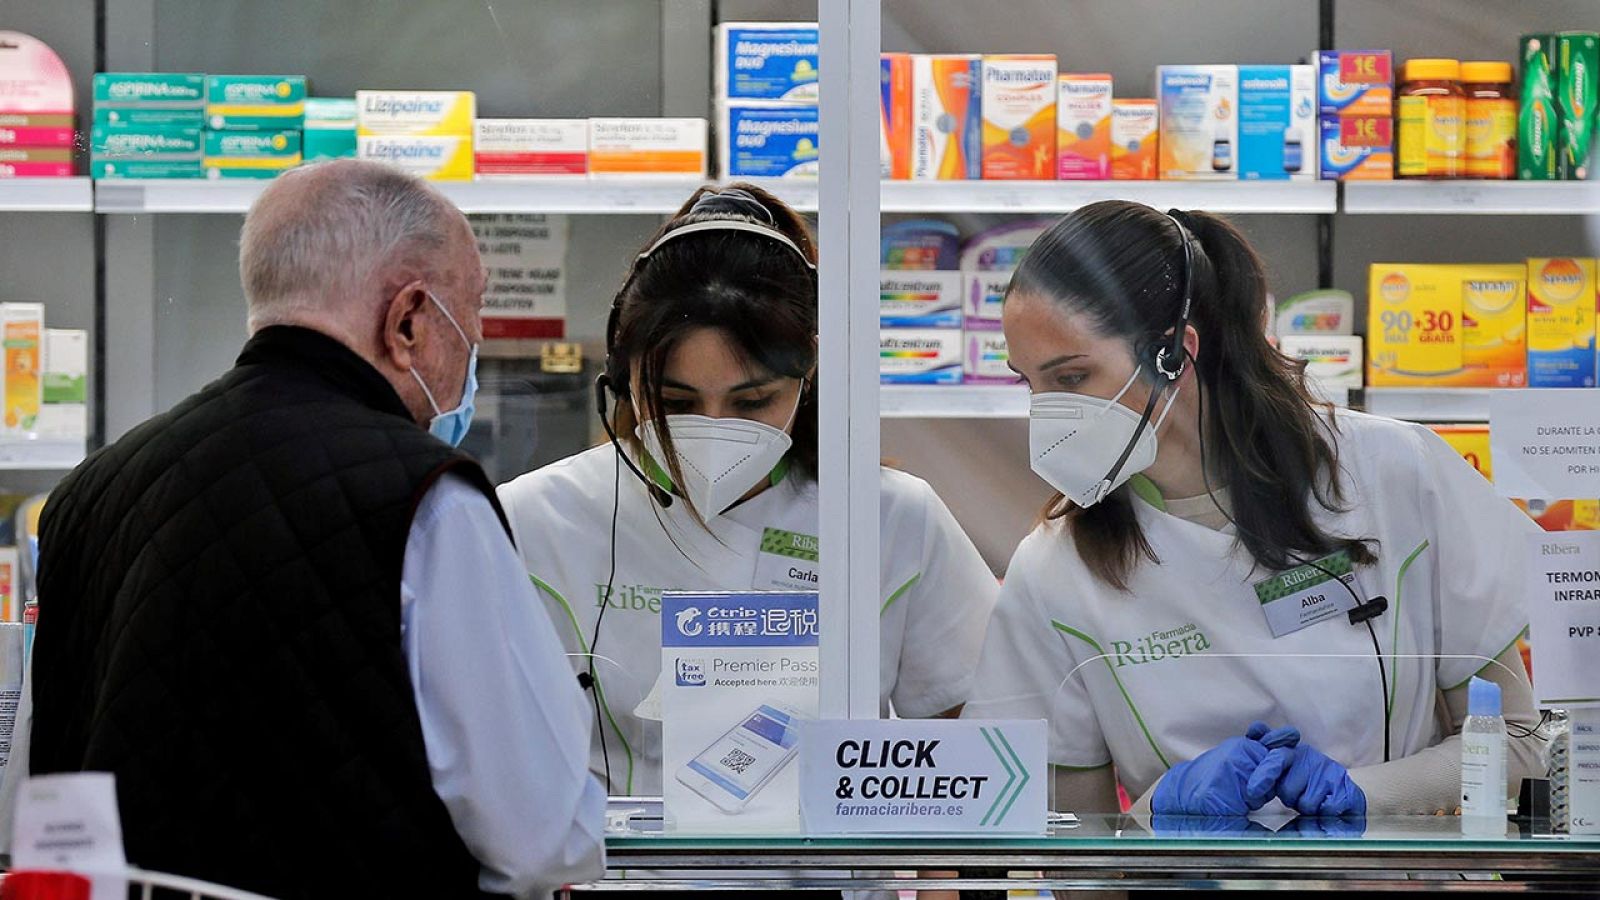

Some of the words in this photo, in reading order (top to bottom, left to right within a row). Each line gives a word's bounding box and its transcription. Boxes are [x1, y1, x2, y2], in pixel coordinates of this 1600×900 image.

[1354, 56, 1376, 75] 1€
[986, 67, 1053, 82] Pharmaton
[109, 82, 168, 97] ASPIRINA
[364, 95, 444, 115] Lizipaina
[1355, 118, 1377, 138] 1€
[364, 142, 445, 160] Lizipaina
[880, 281, 942, 292] ulticentrum
[880, 337, 942, 349] ulticentrum
[1537, 427, 1581, 436] DURANTE
[1584, 427, 1596, 436] LA
[1522, 446, 1538, 455] NO
[1539, 446, 1551, 455] SE
[1552, 446, 1596, 455] ADMITEN
[1568, 465, 1588, 474] POR
[1541, 544, 1581, 556] Ribera
[788, 567, 819, 583] Carla
[1302, 592, 1326, 609] Alba
[760, 608, 819, 636] 退税
[1152, 622, 1198, 641] Farmacia
[1569, 626, 1594, 638] PVP
[1110, 632, 1211, 668] Ribera
[681, 662, 700, 672] tax
[713, 658, 776, 672] Premier
[780, 658, 818, 672] Pass
[682, 672, 704, 681] free
[714, 678, 756, 688] Accepted
[757, 678, 777, 687] here
[835, 739, 941, 769] CLICK
[835, 775, 855, 800] &
[860, 776, 989, 800] COLLECT
[835, 801, 964, 816] farmaciaribera.es
